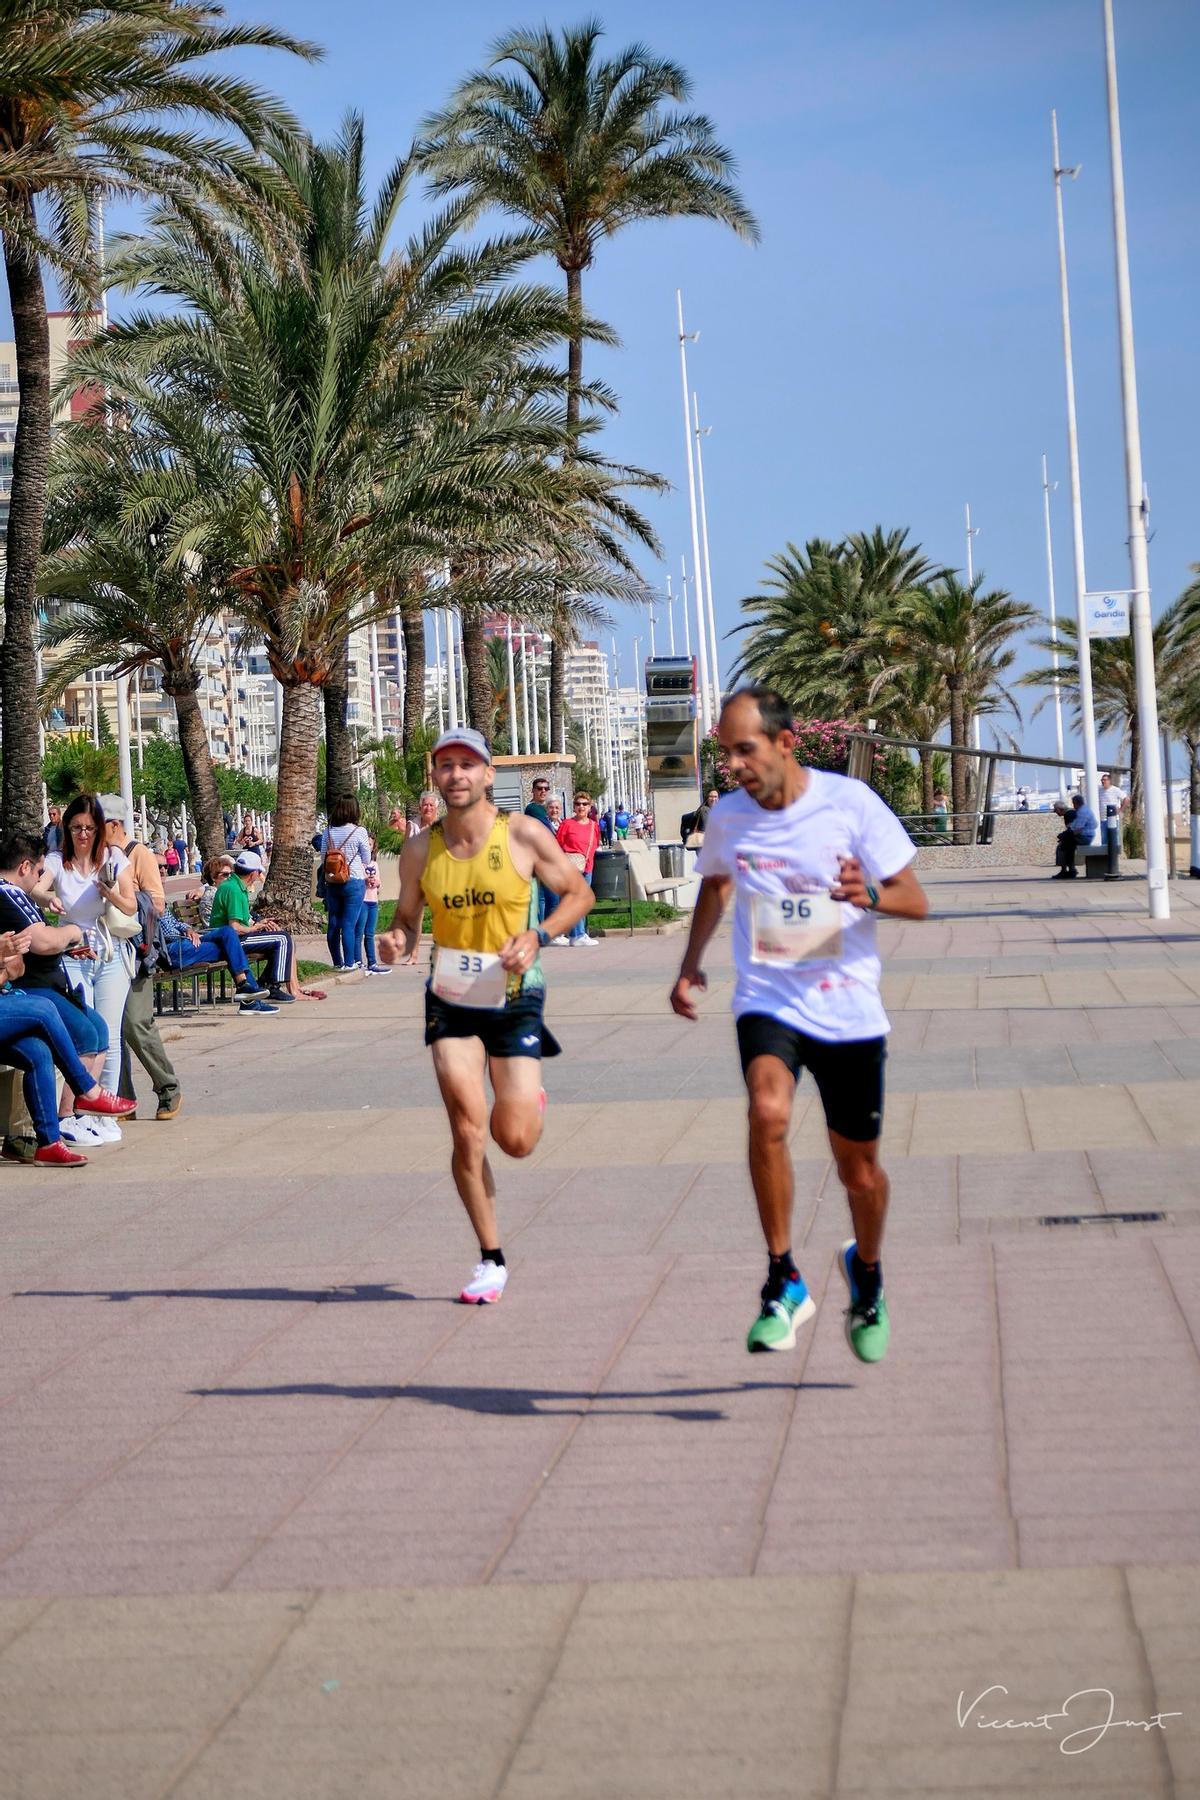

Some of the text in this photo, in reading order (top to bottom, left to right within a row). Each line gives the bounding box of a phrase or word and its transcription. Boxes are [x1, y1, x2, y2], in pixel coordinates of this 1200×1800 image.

[442, 888, 496, 909] teika
[781, 899, 811, 918] 96
[459, 955, 482, 972] 33
